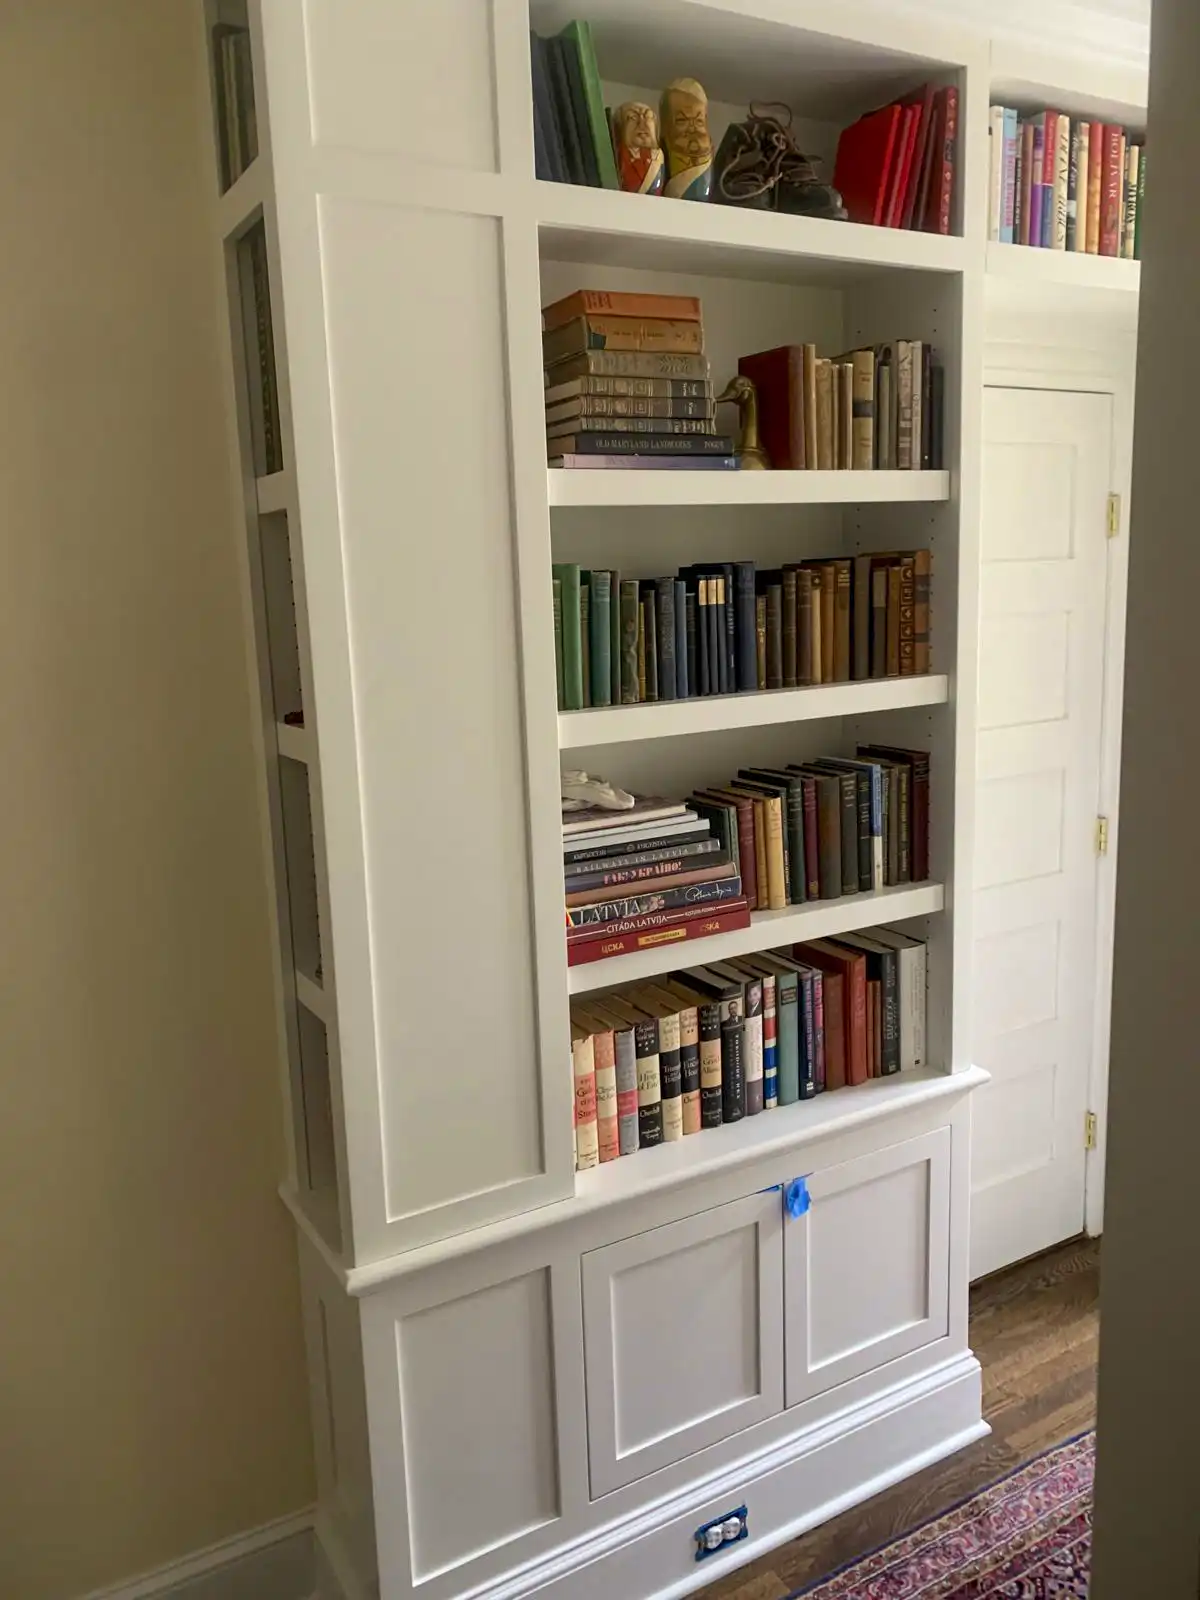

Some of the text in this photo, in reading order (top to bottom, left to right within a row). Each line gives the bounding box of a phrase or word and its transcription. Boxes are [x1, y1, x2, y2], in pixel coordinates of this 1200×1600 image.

[1108, 133, 1119, 199] BOLIVAR
[611, 440, 649, 449] MARYLAND
[650, 440, 693, 450] LANDMARKS
[576, 858, 630, 874] RAILWAYS
[651, 847, 690, 862] LATVIA
[578, 899, 642, 926] LATVIA
[636, 914, 668, 929] LATVIJA
